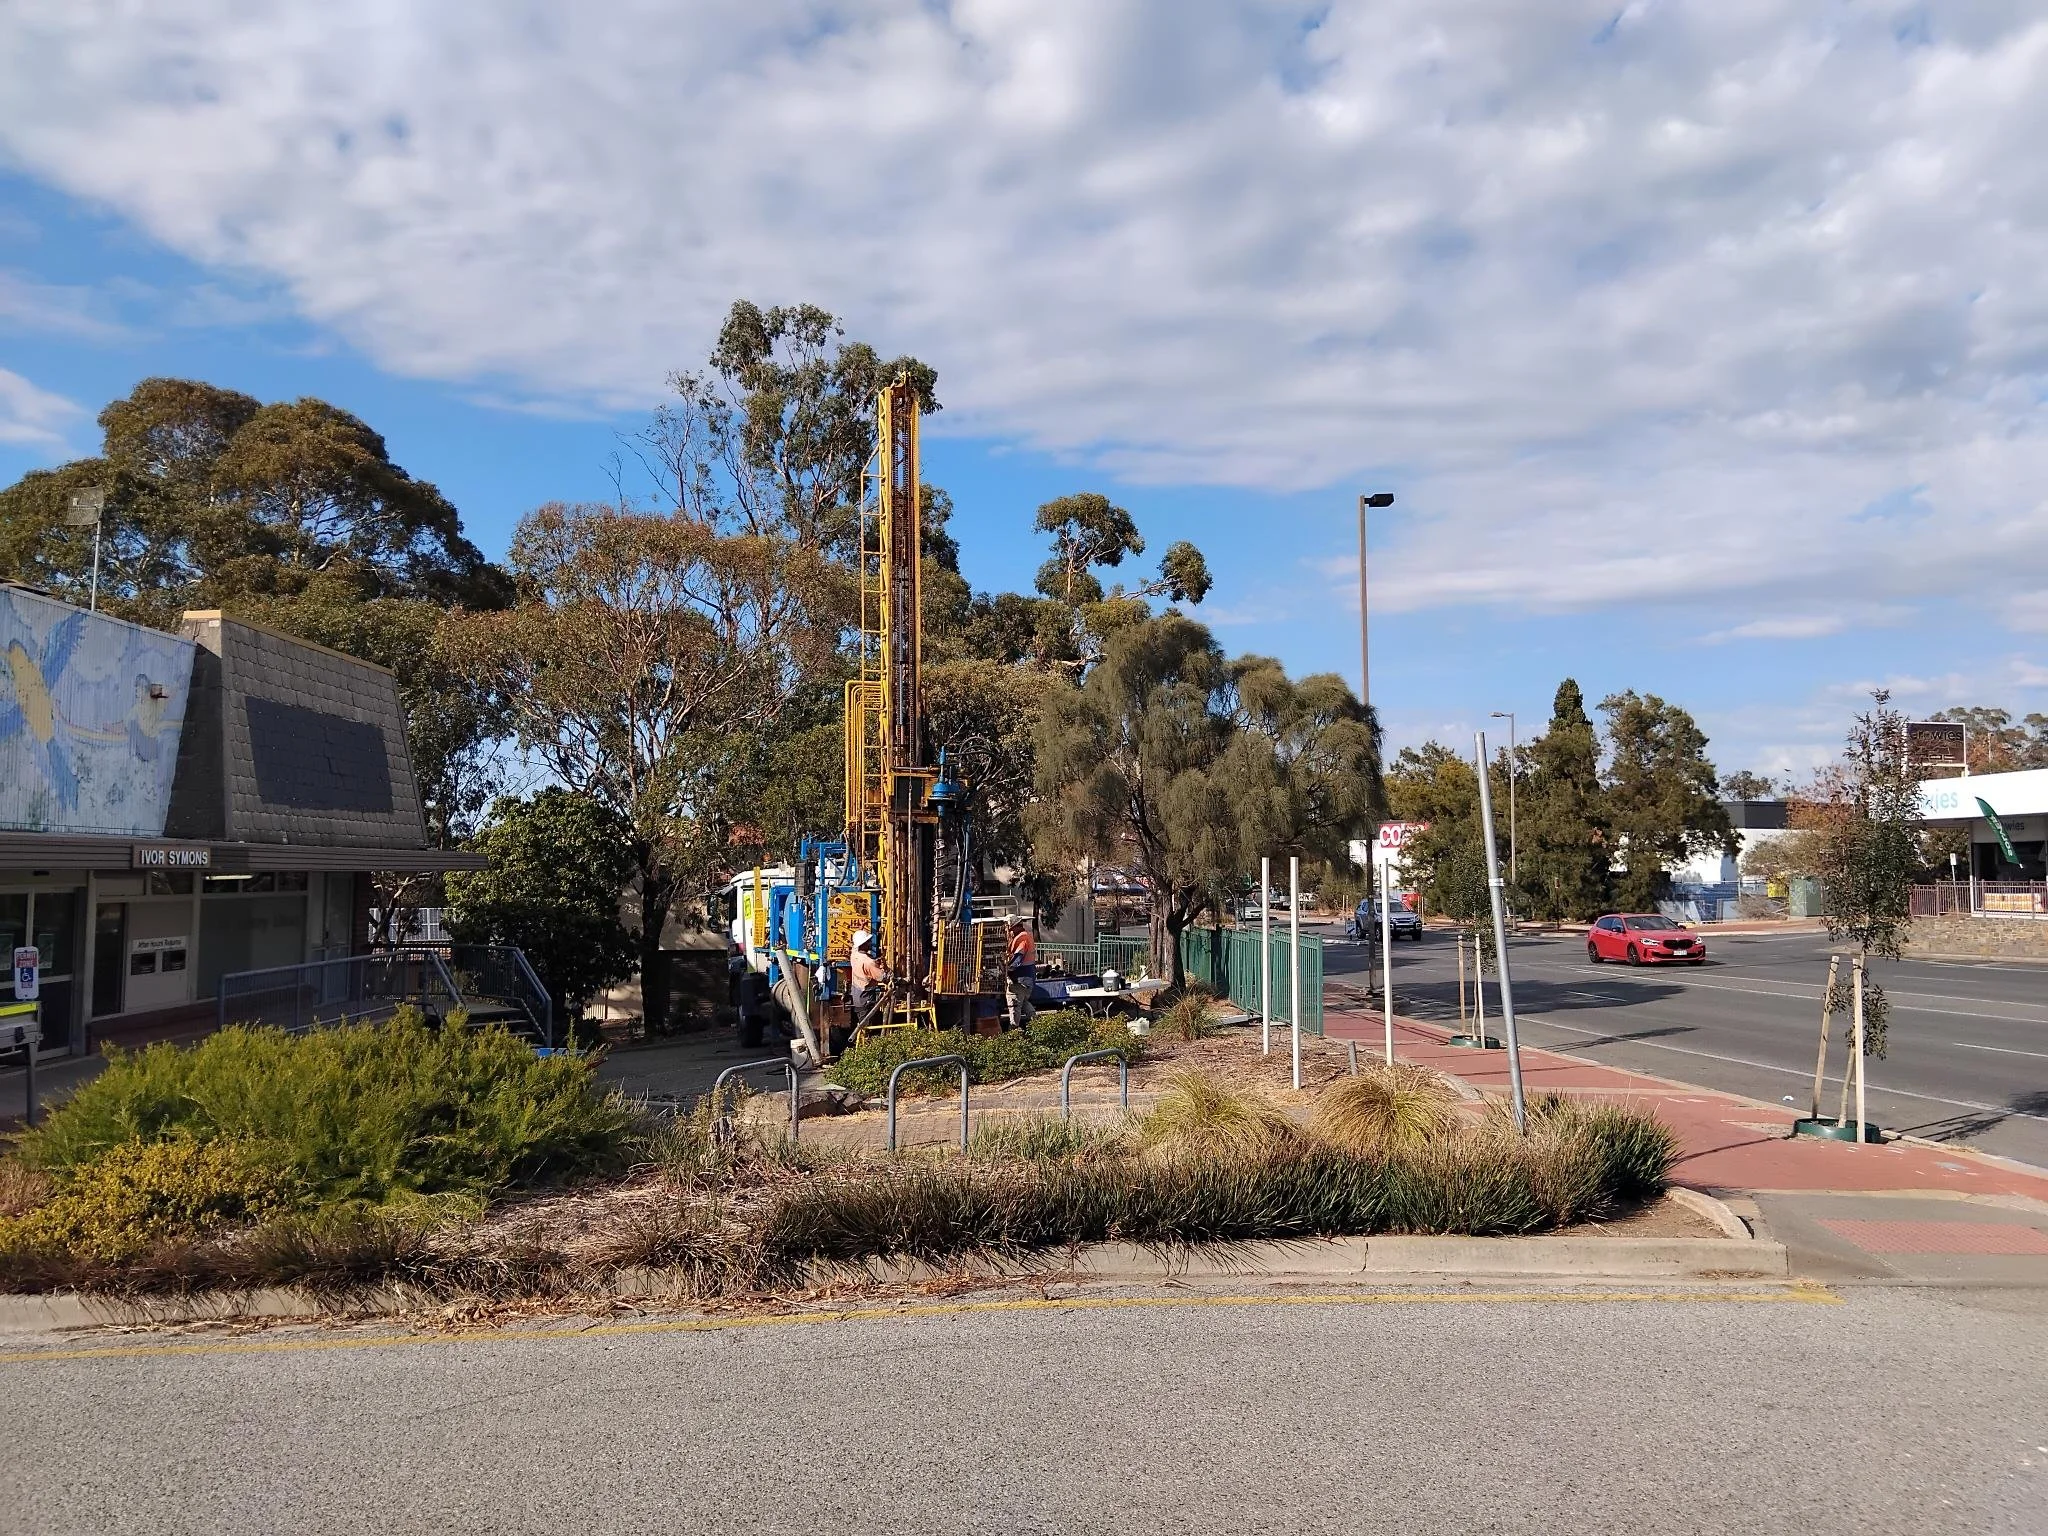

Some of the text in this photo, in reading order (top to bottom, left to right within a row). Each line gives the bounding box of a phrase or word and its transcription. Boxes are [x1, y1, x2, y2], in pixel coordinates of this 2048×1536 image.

[141, 849, 208, 865] IVOR SYMONS
[16, 952, 37, 960] PERMIT
